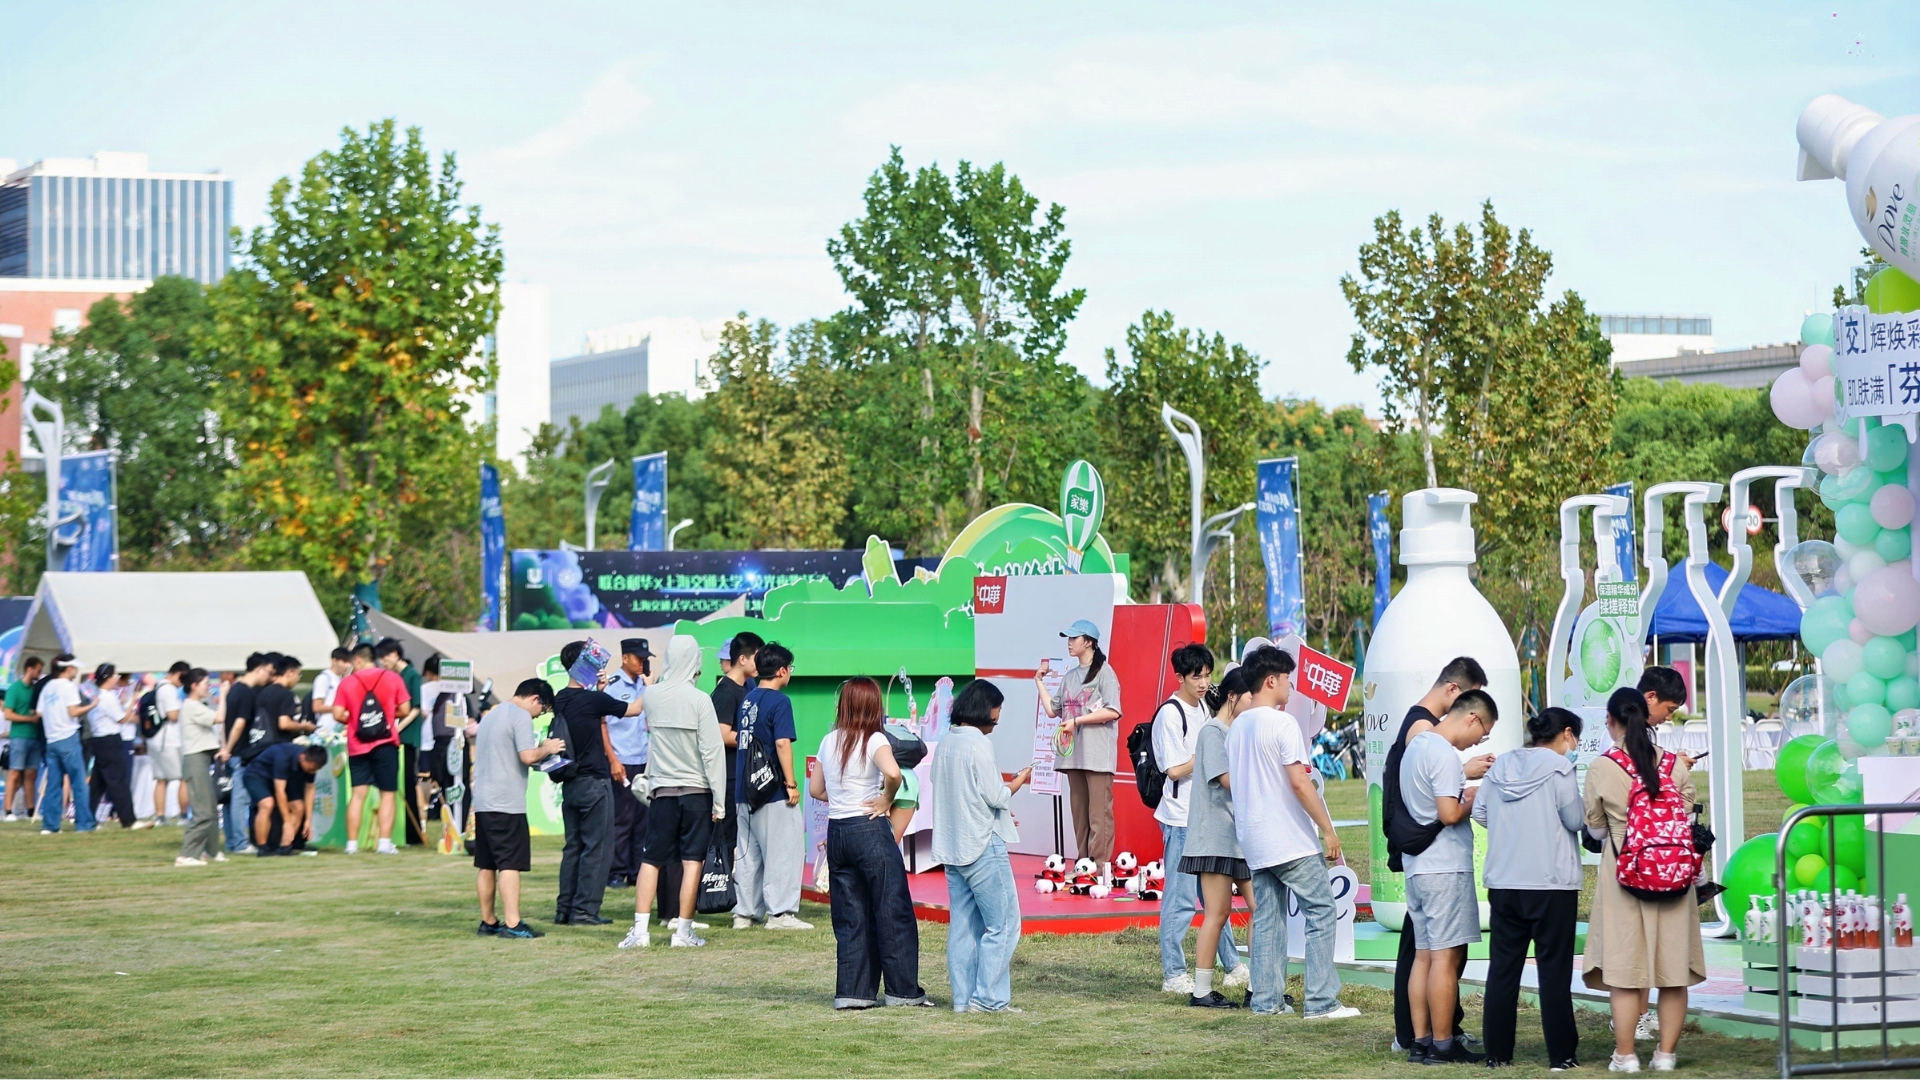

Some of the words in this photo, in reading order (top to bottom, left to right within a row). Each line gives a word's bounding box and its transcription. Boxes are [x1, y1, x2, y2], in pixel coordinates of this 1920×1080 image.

[1877, 183, 1905, 253] Dove
[1747, 515, 1759, 527] 30
[1600, 598, 1638, 615] 揉搓释放
[1307, 663, 1343, 698] 中華
[1364, 712, 1389, 732] ove
